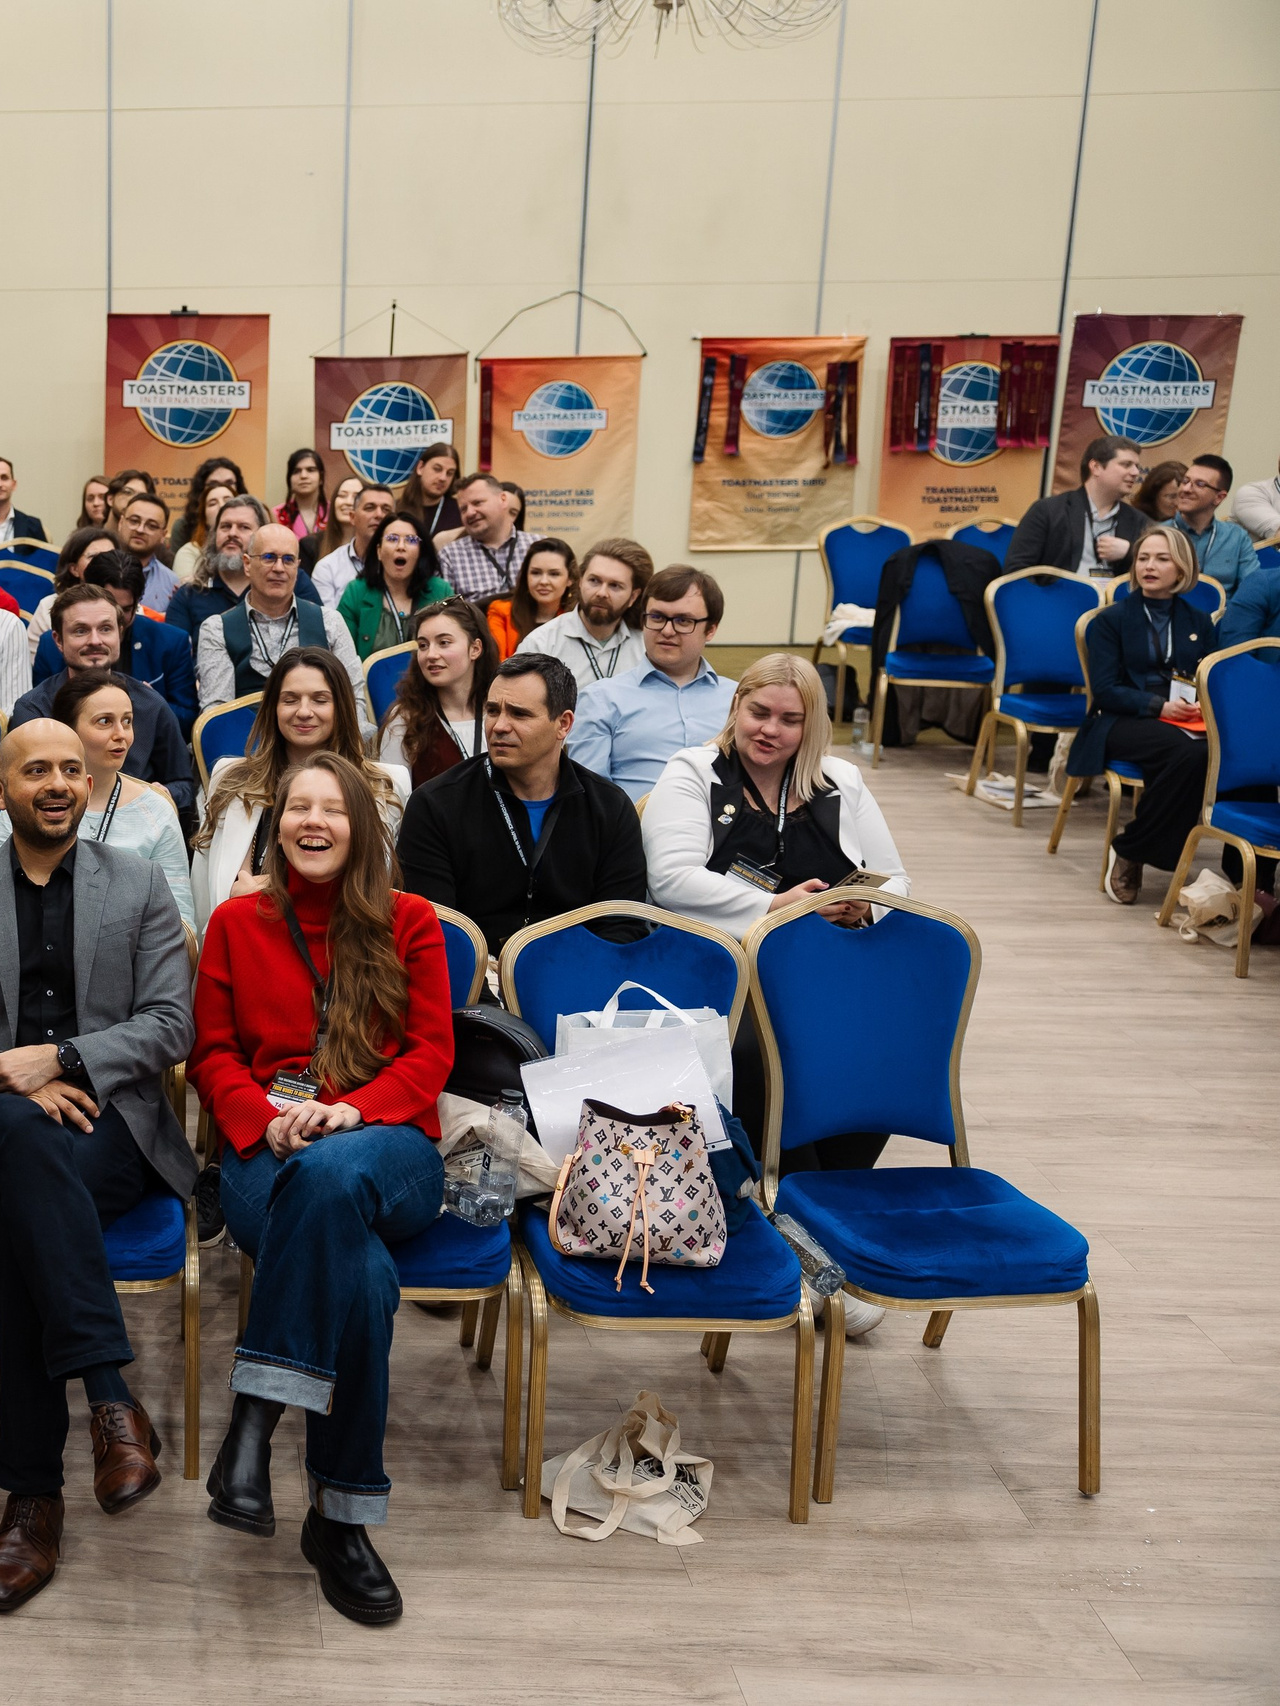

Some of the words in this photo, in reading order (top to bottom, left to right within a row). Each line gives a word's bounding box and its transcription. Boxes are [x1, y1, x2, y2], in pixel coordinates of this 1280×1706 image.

[128, 384, 246, 396] TOASTMASTERS
[1090, 383, 1210, 396] TOASTMASTERS
[744, 391, 826, 400] OASTMASTERS
[139, 396, 232, 405] INTERNATIONAL
[1100, 397, 1195, 406] INTERNATIONAL
[941, 405, 998, 415] STMAST
[517, 411, 603, 421] TOASTMASTERS
[336, 423, 448, 437] TOASTMASTERS
[722, 479, 799, 487] TOASTMASTERS
[524, 489, 572, 497] POTLIGHT
[925, 486, 997, 494] TRANSILVANIA
[922, 496, 999, 504] TOASTMASTERS
